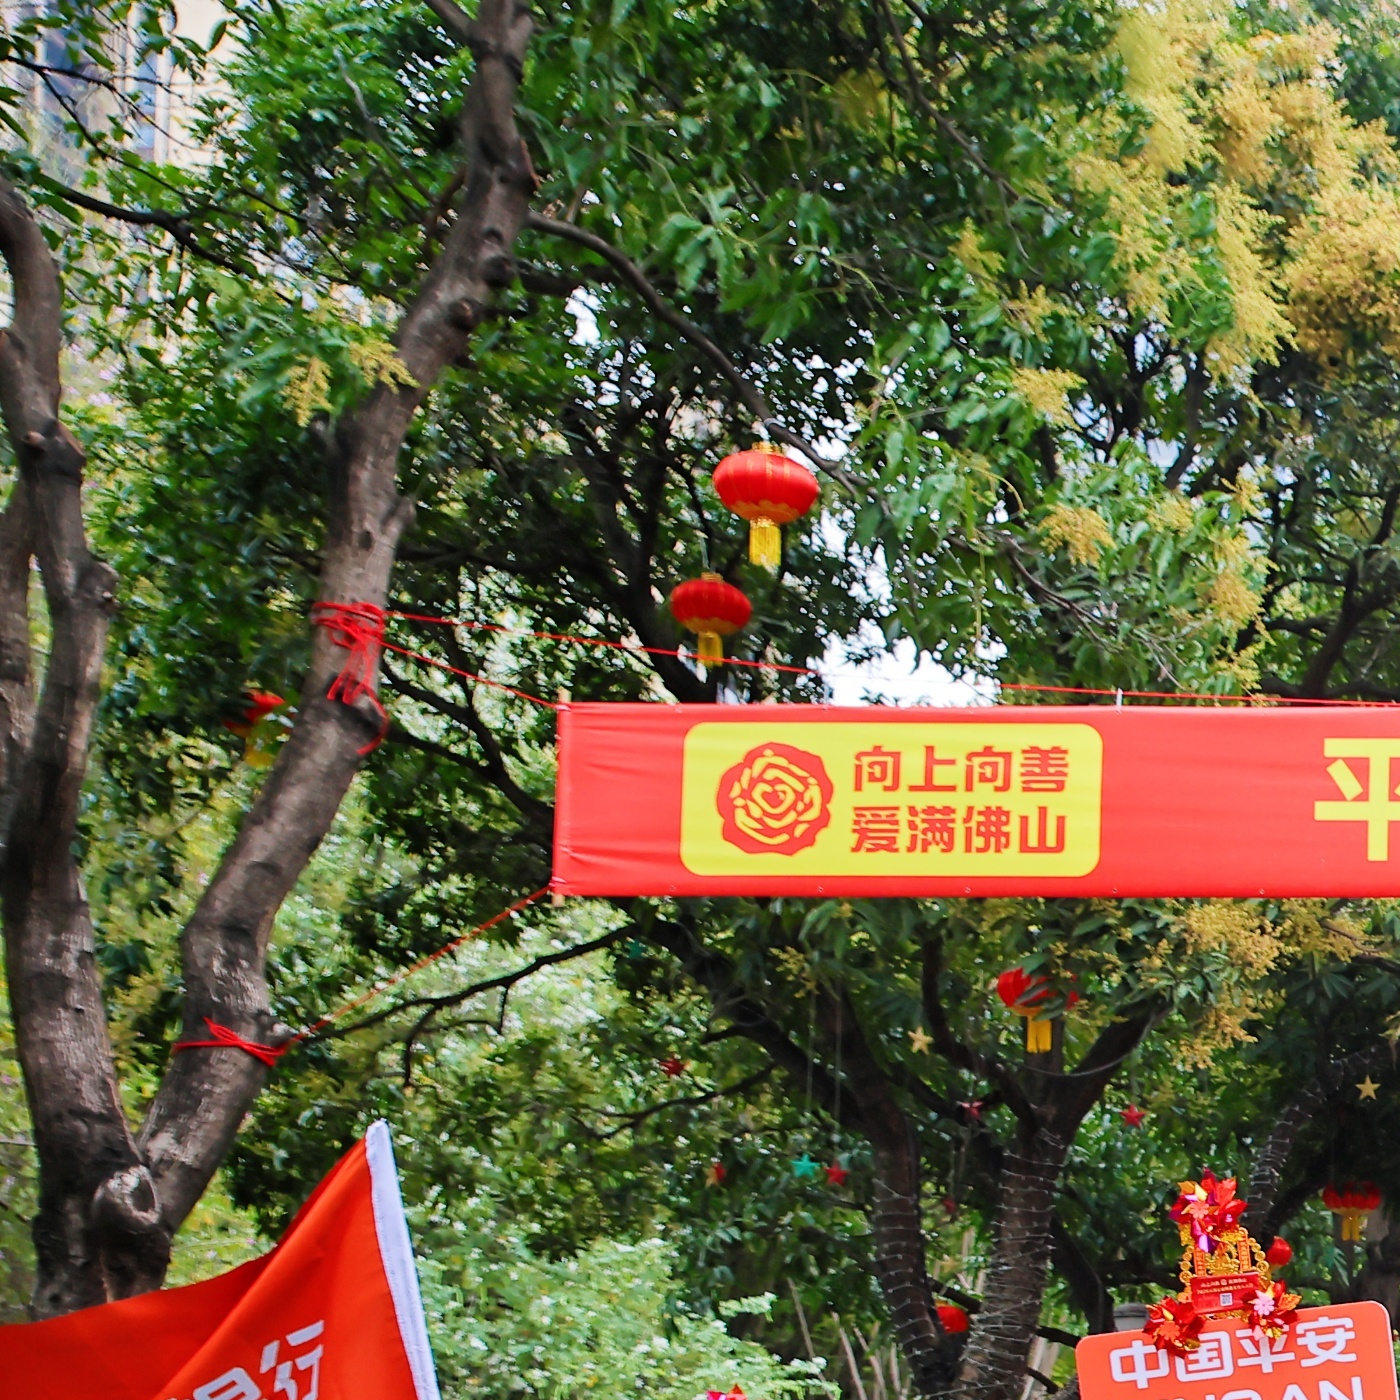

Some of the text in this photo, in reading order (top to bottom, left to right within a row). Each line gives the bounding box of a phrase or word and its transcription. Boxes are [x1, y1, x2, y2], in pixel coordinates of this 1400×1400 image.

[853, 745, 1069, 793] 向上向善
[850, 804, 1067, 855] 爱满佛山
[1110, 1315, 1358, 1390] 中国平安
